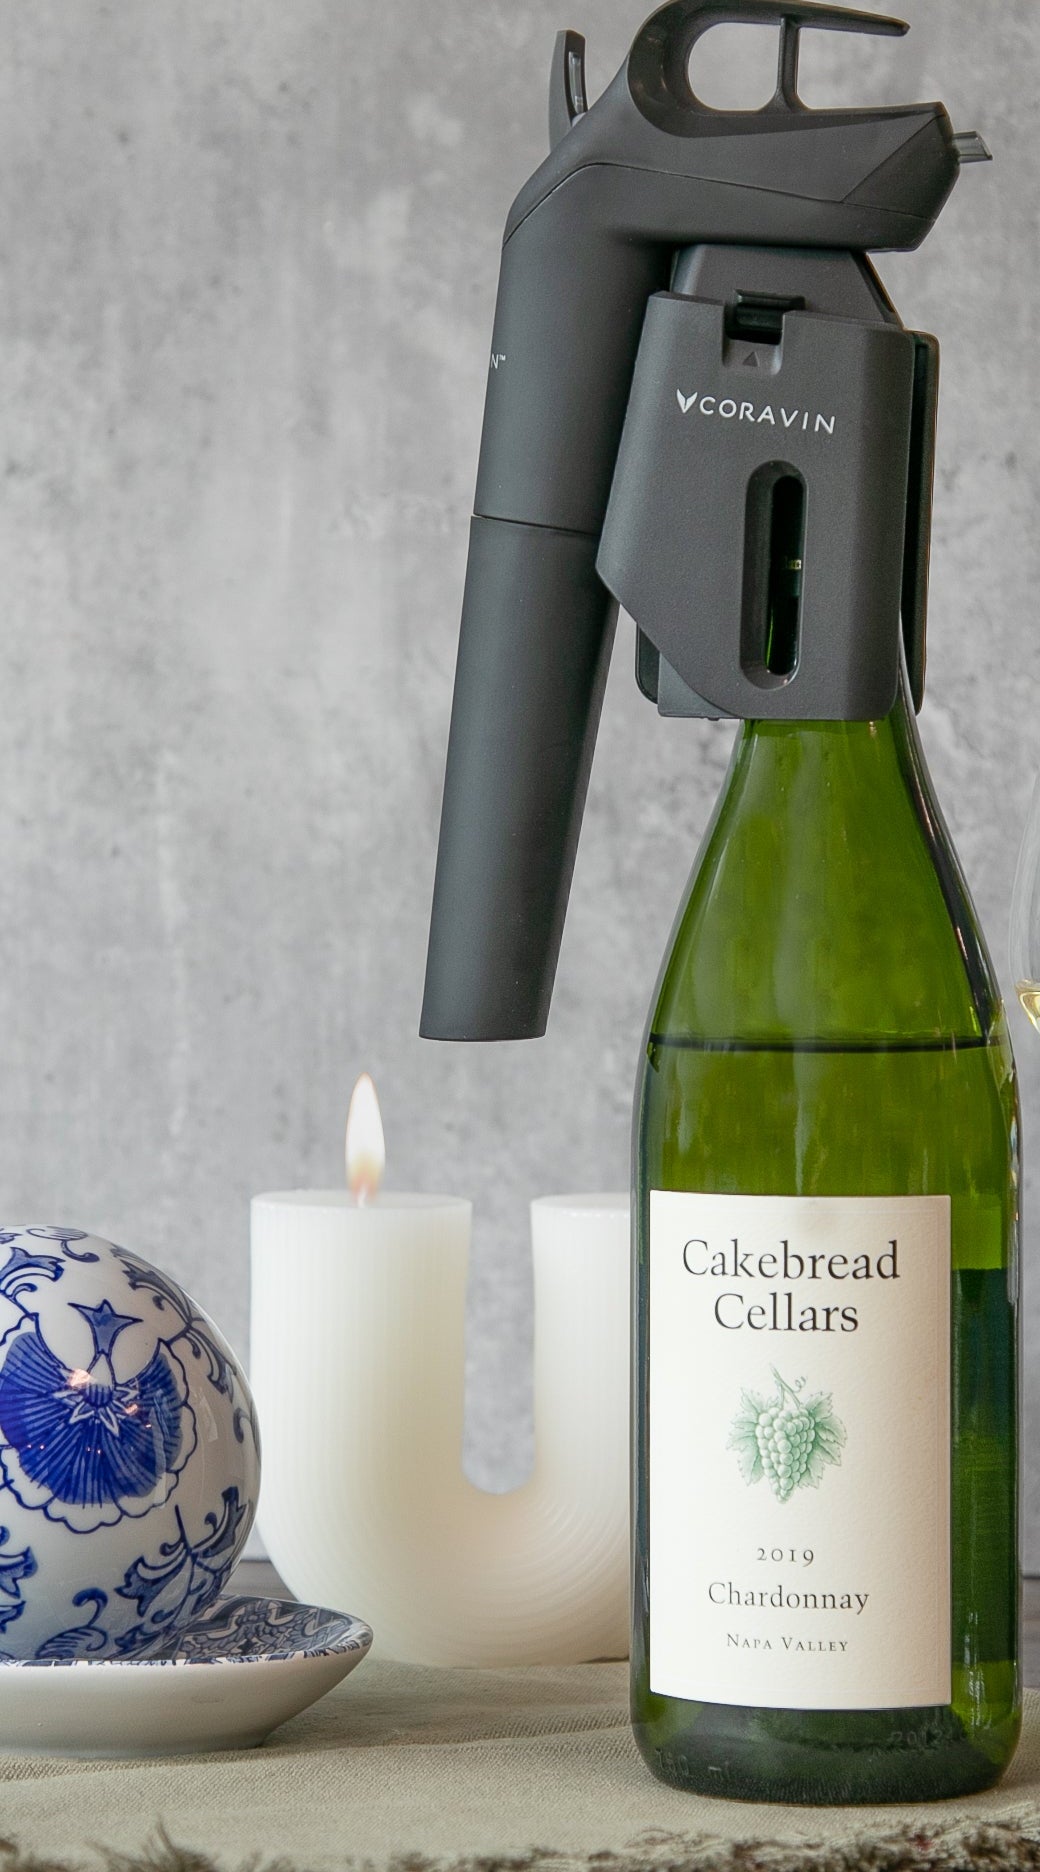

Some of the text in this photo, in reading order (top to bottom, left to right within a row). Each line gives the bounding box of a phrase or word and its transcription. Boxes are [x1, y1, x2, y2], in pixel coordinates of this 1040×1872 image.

[699, 395, 837, 435] CORAVIN
[682, 1237, 902, 1281] Cakebread
[714, 1292, 860, 1333] Cellars
[756, 1546, 816, 1568] 2019
[708, 1581, 870, 1616] Chardonnay
